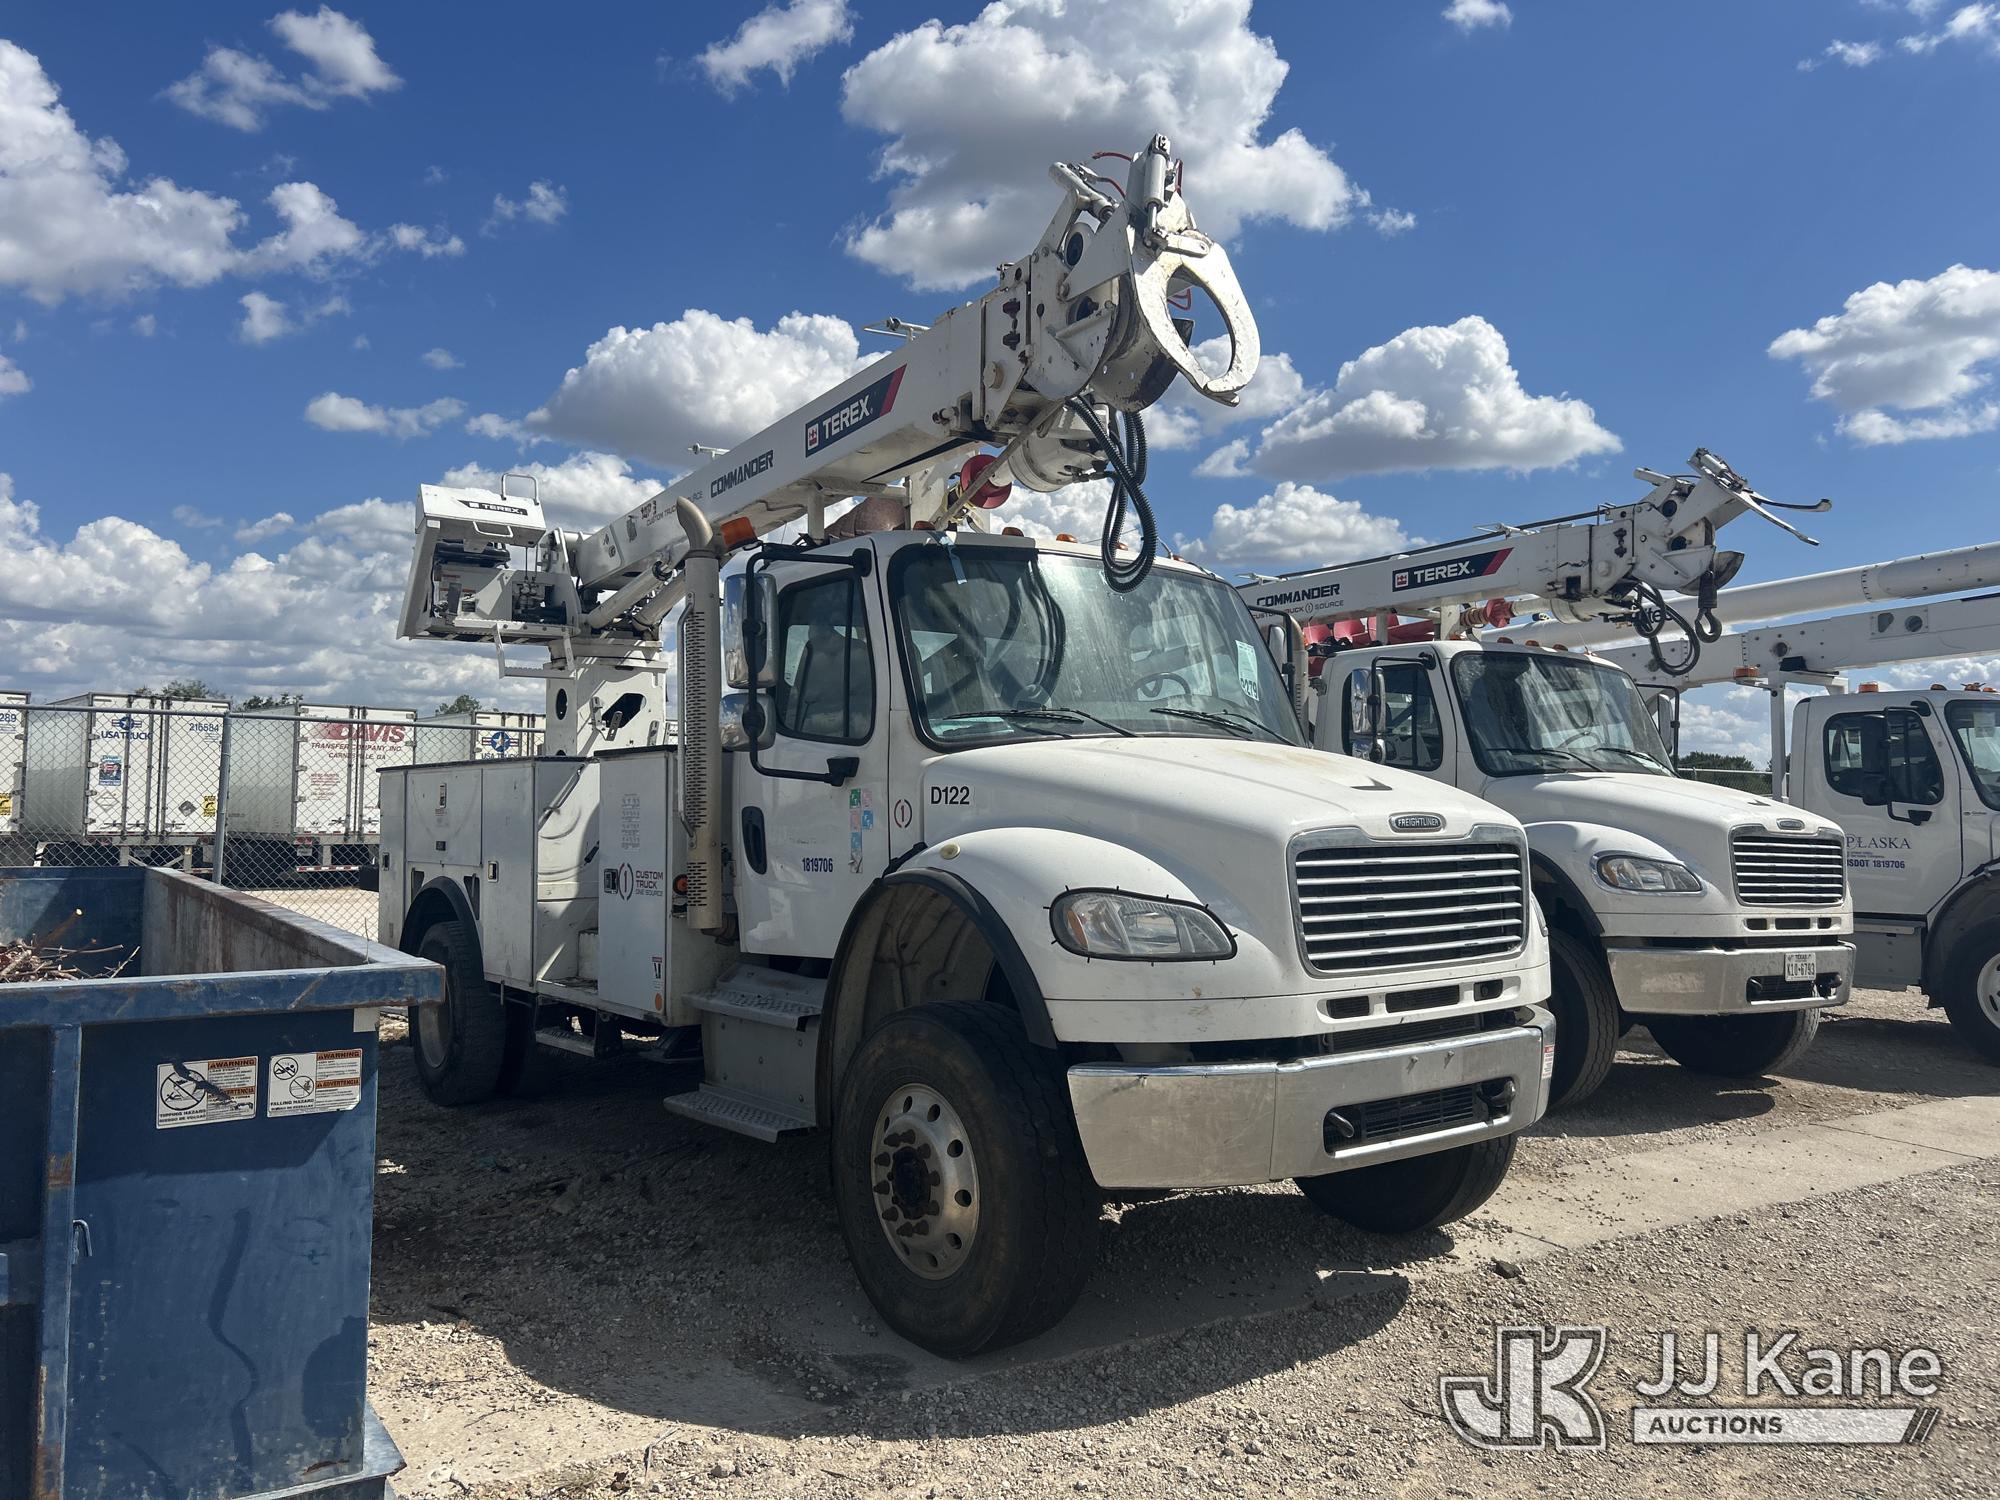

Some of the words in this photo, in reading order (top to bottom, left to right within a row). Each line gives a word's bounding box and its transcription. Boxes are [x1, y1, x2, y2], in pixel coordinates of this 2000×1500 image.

[822, 394, 871, 440] TEREX
[710, 449, 774, 499] COMMANDER
[482, 503, 520, 514] TEREX
[1413, 560, 1471, 584] TEREX
[1256, 583, 1341, 608] COMMANDER
[1314, 600, 1345, 610] SOURCE
[101, 730, 120, 739] USA
[930, 786, 970, 805] D122
[1397, 817, 1439, 827] FREIGHTLINER
[802, 857, 834, 873] 1819706
[1872, 860, 1906, 869] 1819706
[635, 870, 664, 880] CUSTOM
[635, 879, 657, 890] TRUCK
[324, 1051, 360, 1059] WARNING
[215, 1059, 255, 1068] WARNING
